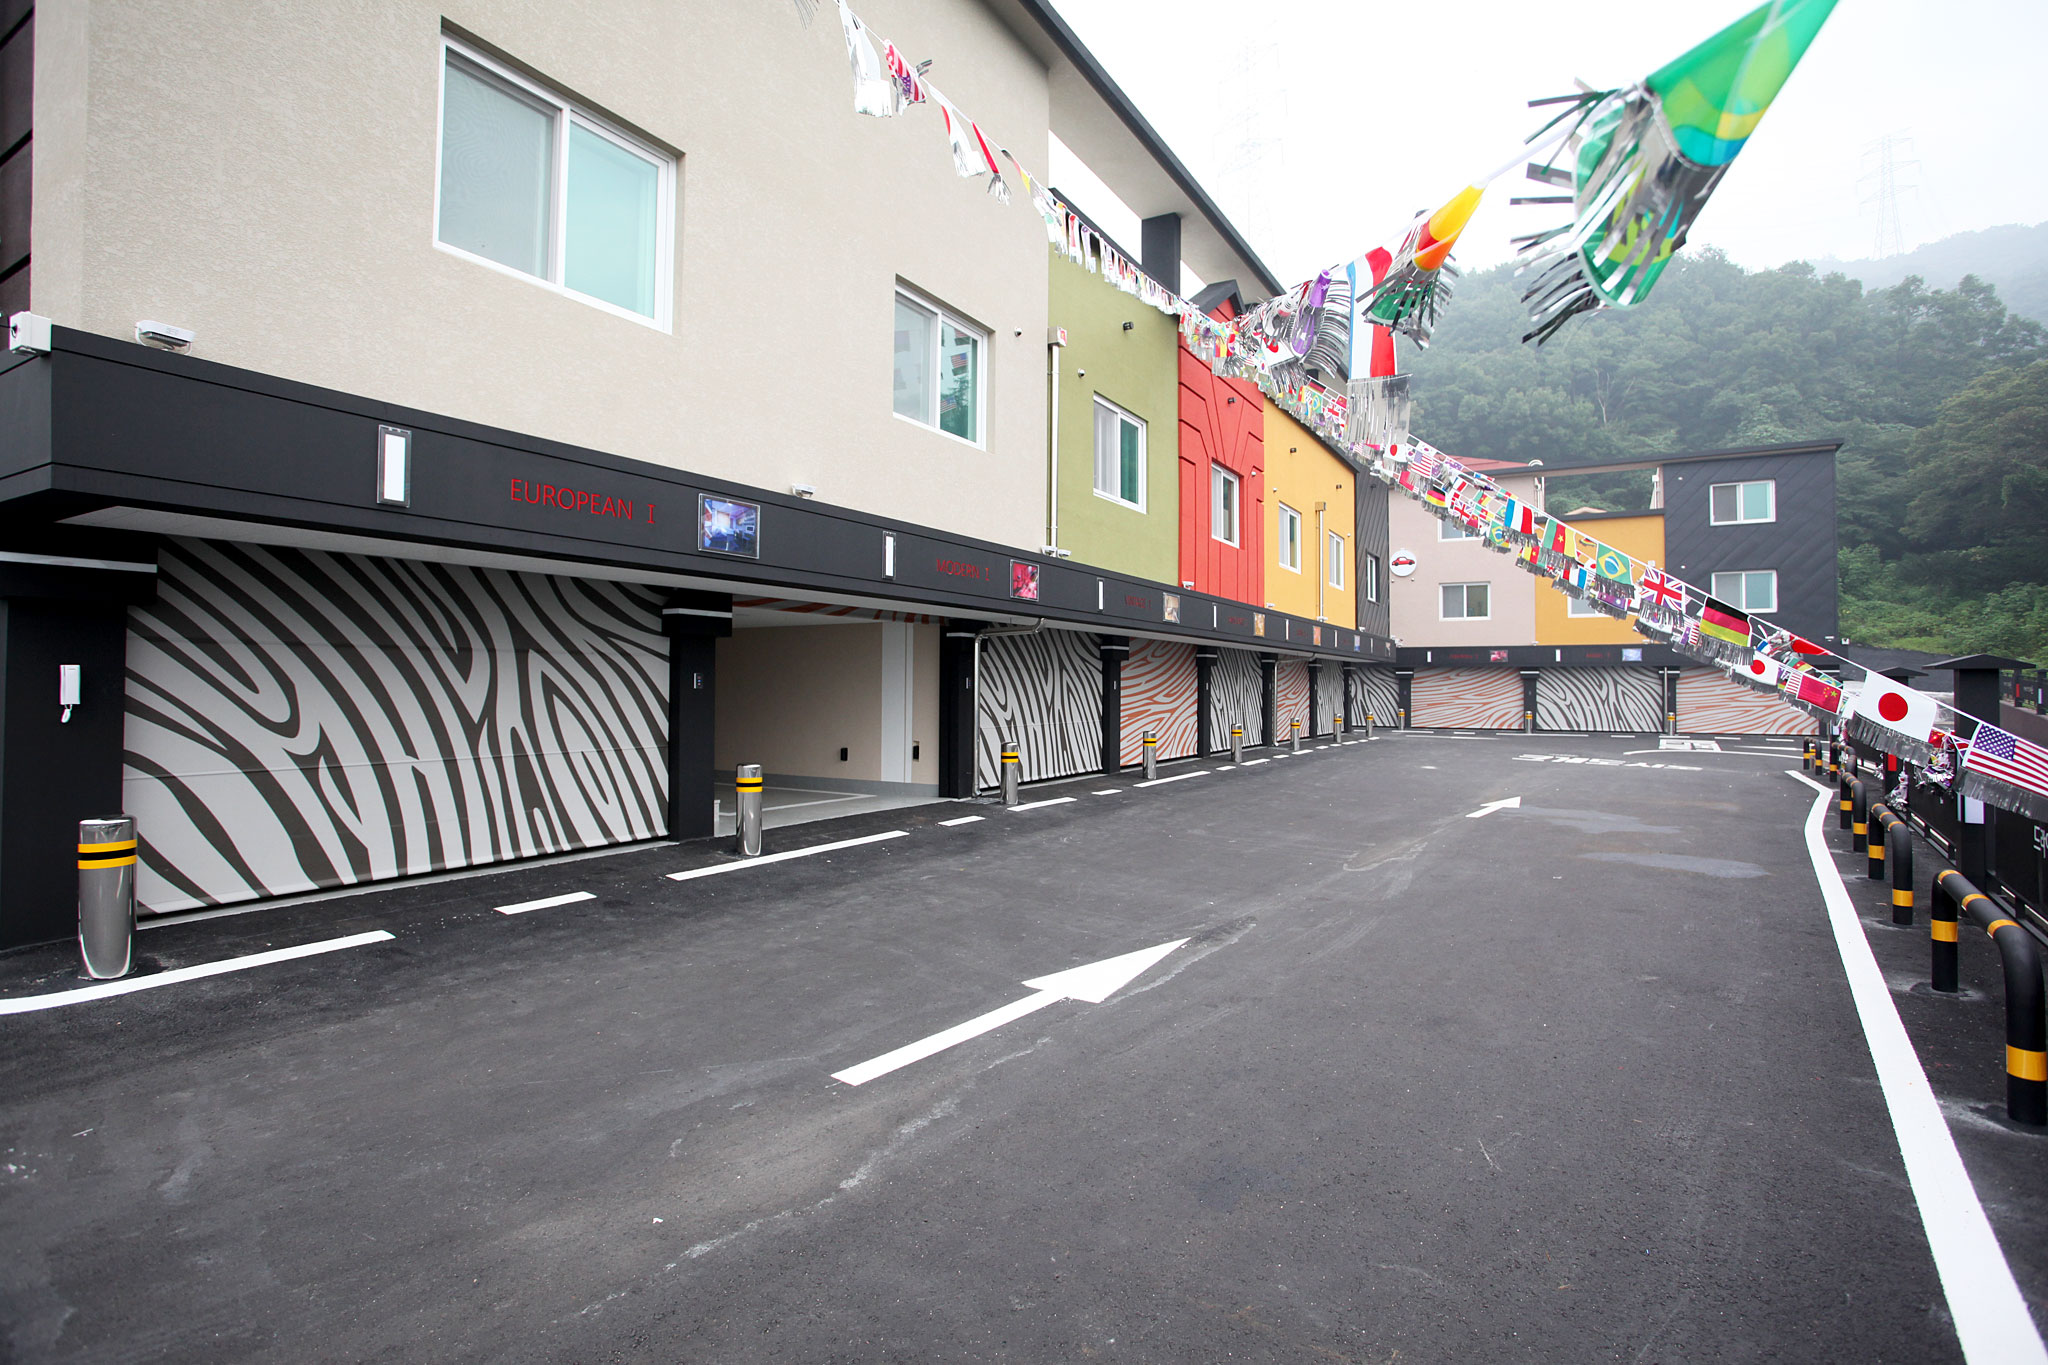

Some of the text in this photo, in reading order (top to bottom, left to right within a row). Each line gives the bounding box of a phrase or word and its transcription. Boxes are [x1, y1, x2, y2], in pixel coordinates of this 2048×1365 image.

[511, 478, 656, 524] EUROPEAN I
[936, 558, 980, 579] MODERN
